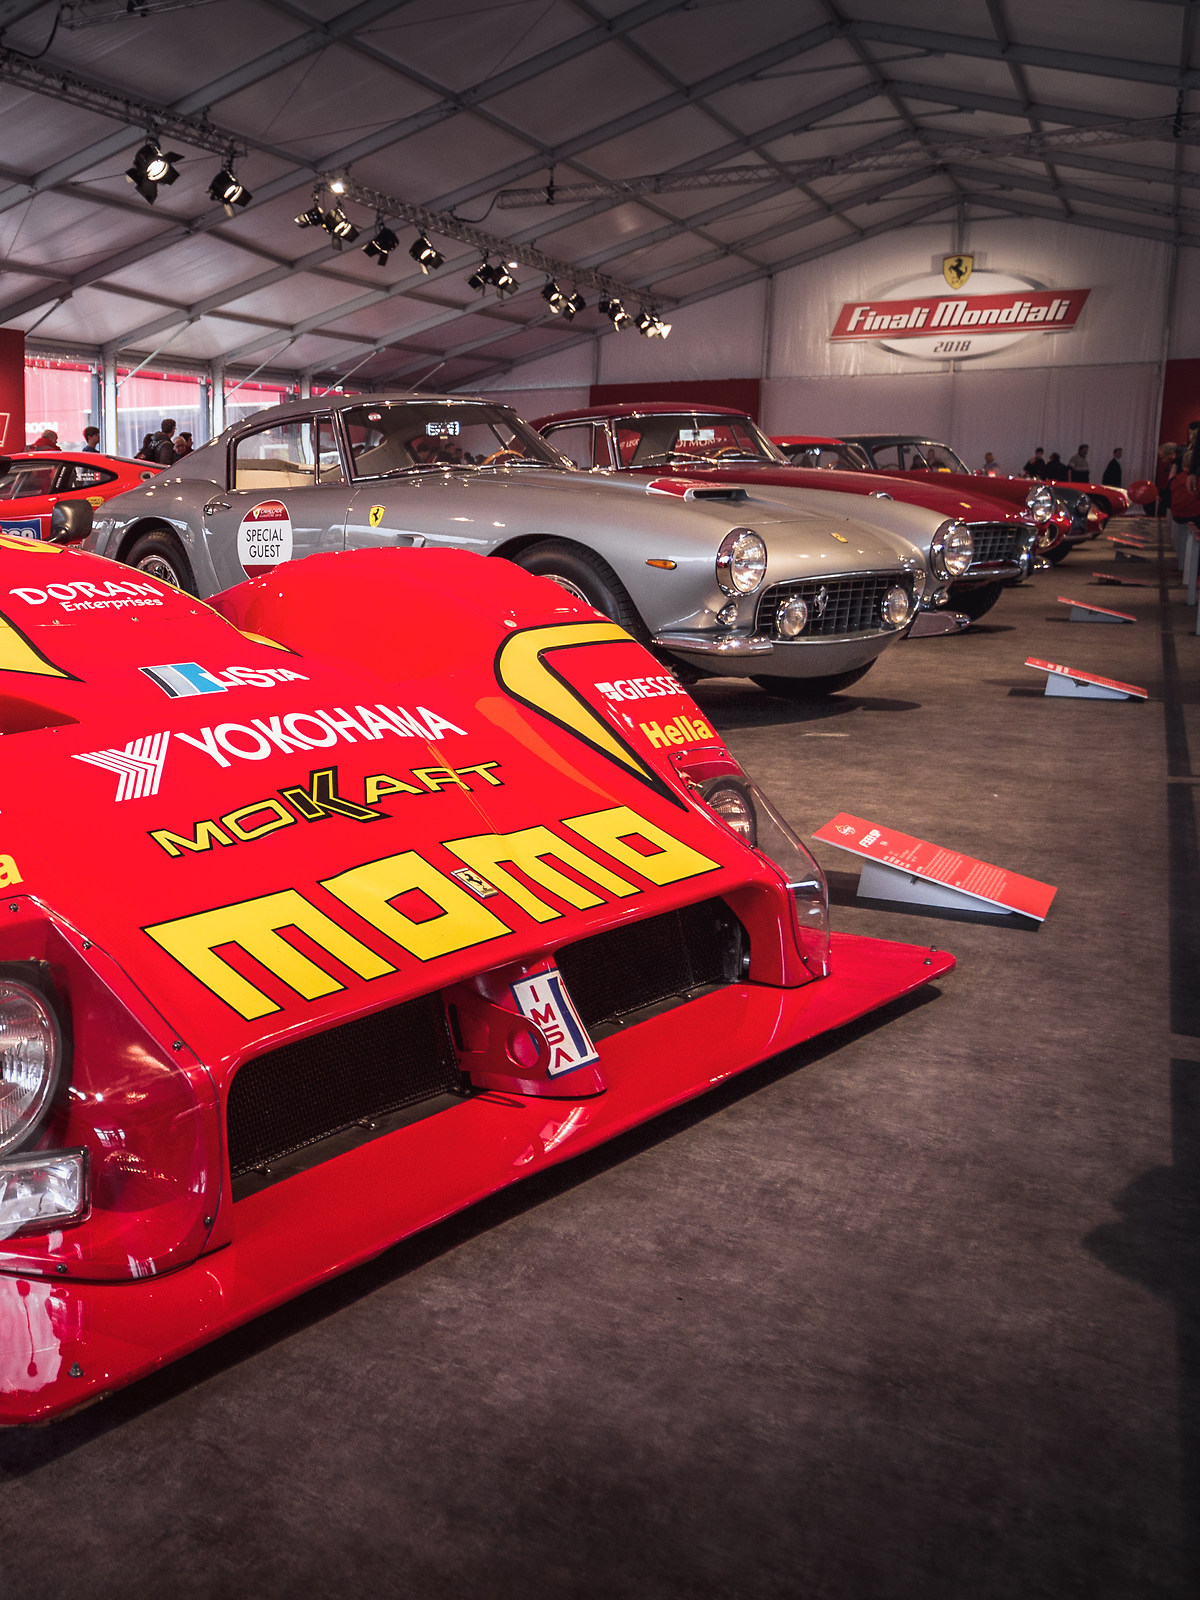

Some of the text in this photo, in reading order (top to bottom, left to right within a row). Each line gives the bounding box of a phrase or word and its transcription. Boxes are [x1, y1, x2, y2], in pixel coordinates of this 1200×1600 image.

[846, 299, 1071, 331] Finali Mondiali
[934, 340, 971, 353] 2018
[246, 529, 283, 542] SPECIAL
[249, 545, 280, 558] GUEST
[8, 581, 164, 605] DORAN
[59, 597, 164, 612] Enterprises
[614, 676, 688, 700] GIESSE
[174, 704, 468, 768] YOKOHAMA
[639, 715, 714, 748] Hella
